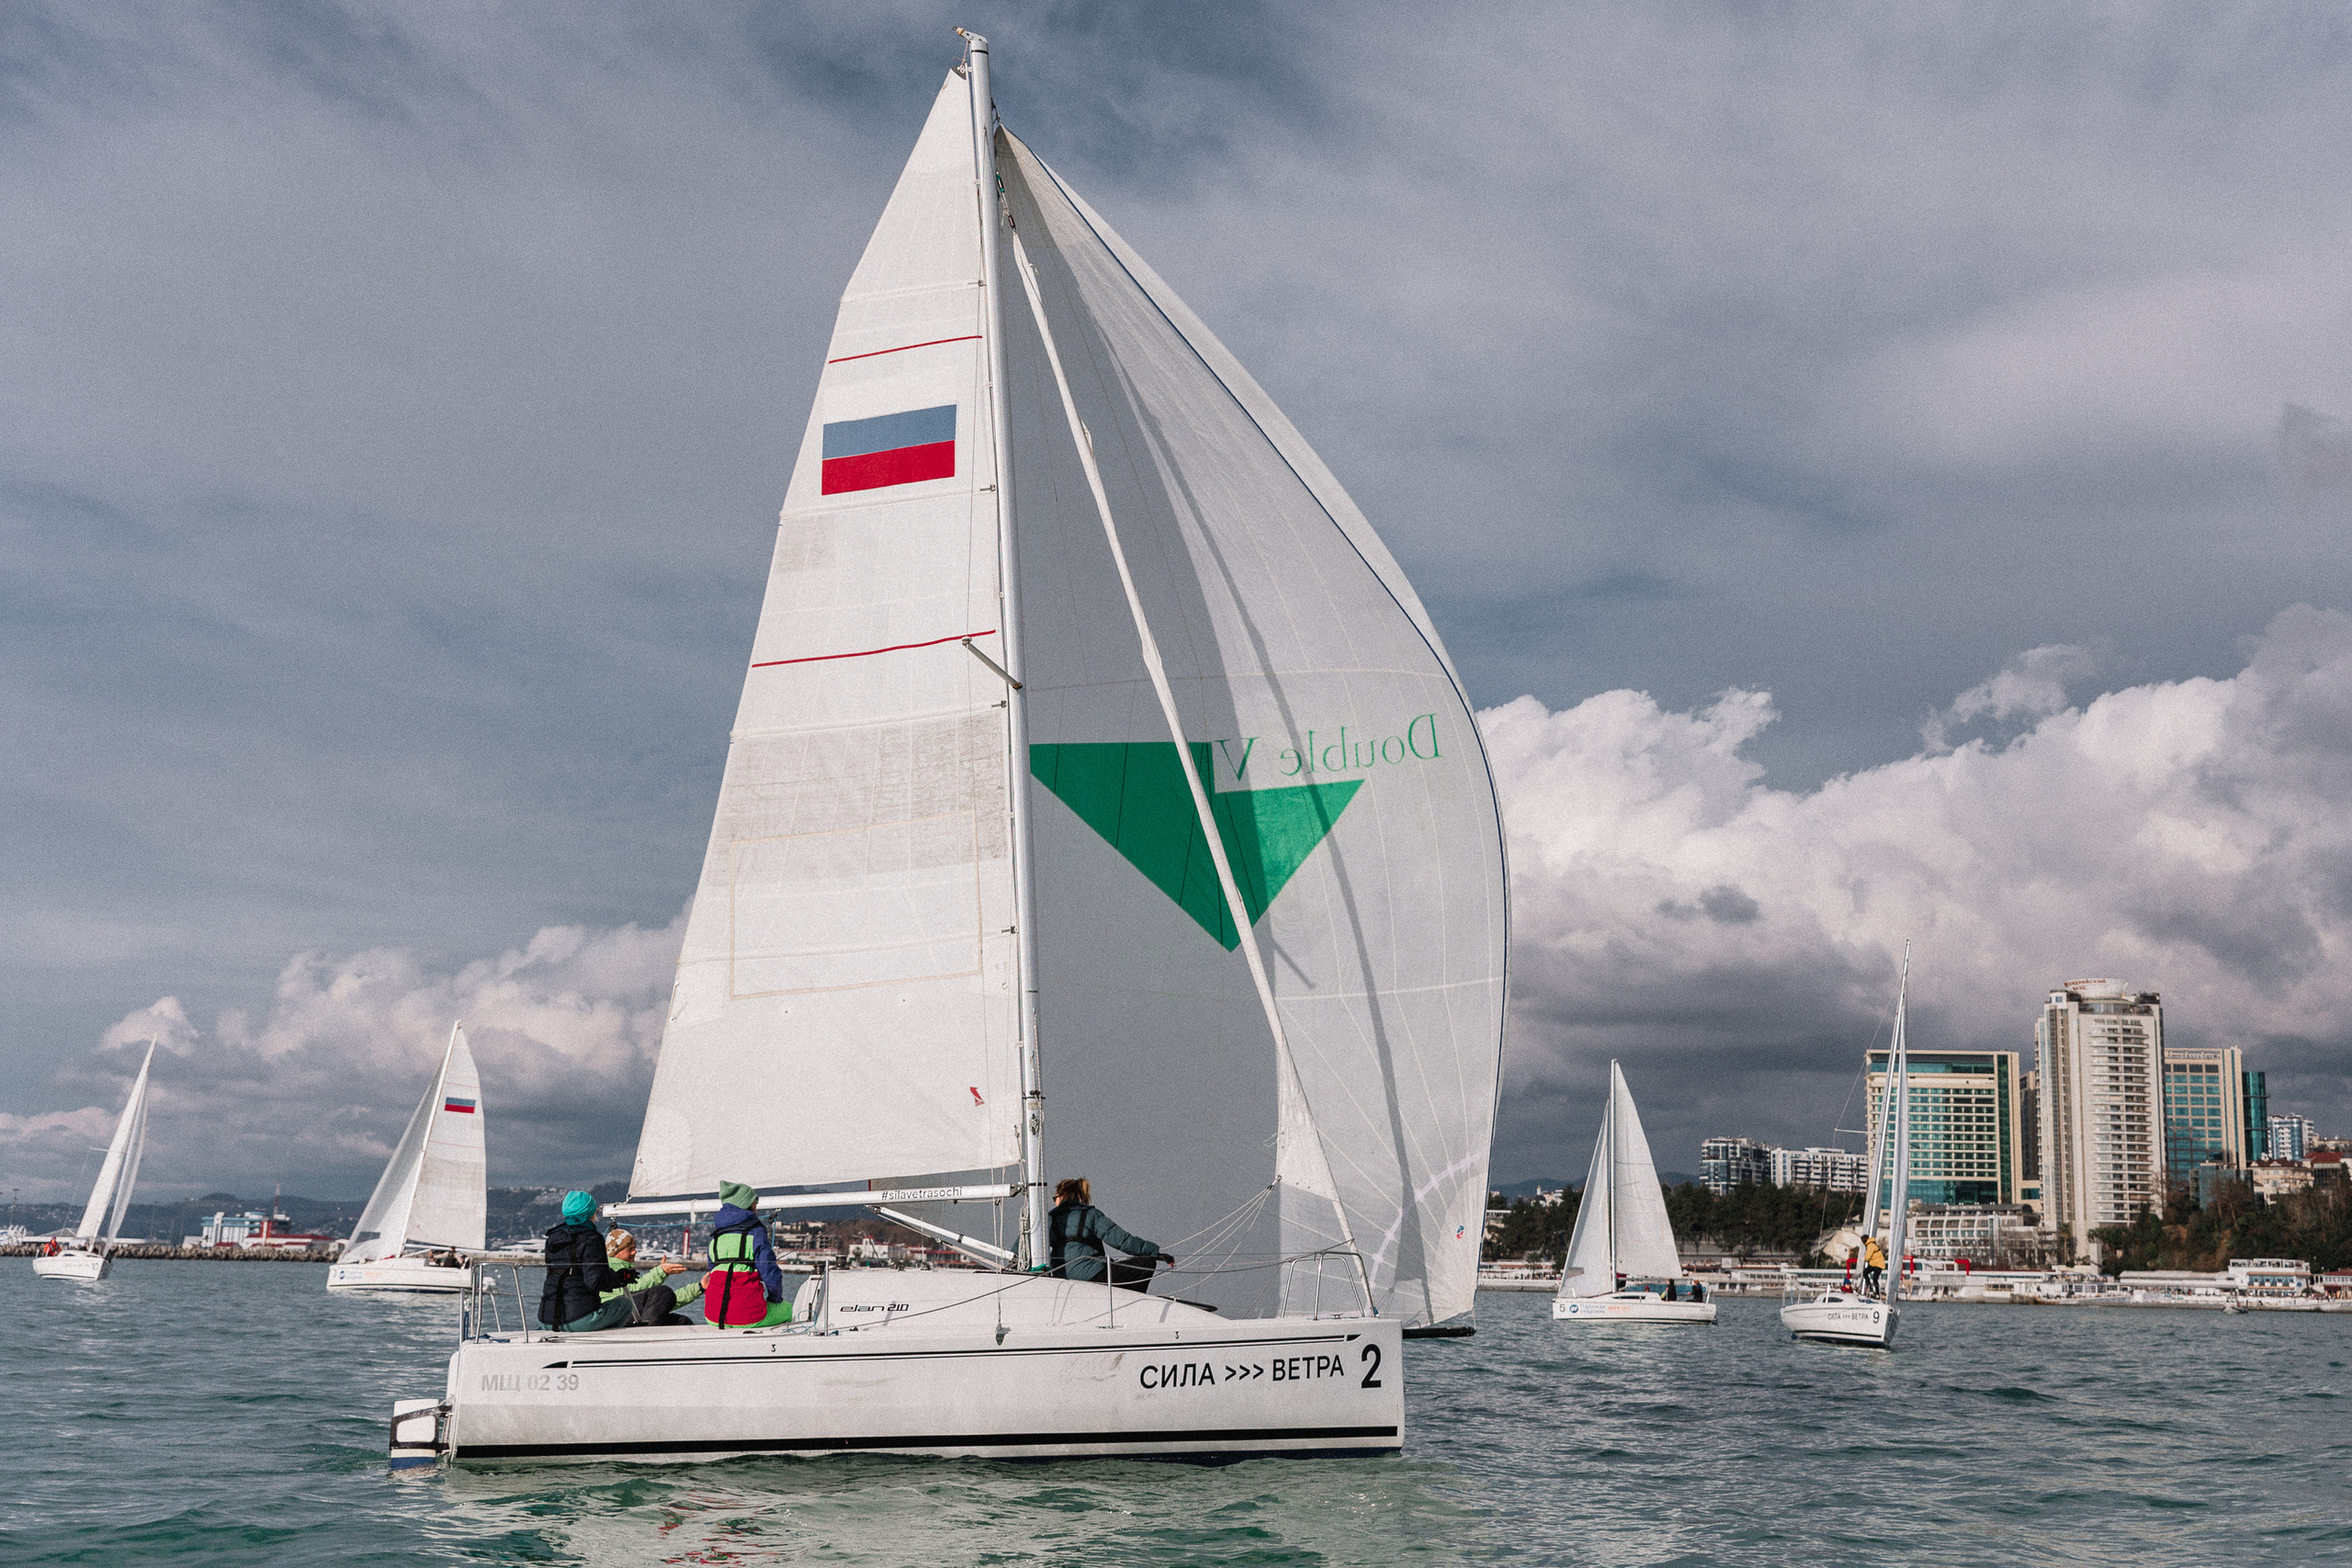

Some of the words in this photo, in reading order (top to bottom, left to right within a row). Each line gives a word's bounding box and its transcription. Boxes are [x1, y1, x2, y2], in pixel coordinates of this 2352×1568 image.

[881, 1186, 963, 1201] #silavetrasochi
[840, 1303, 885, 1312] elan
[887, 1303, 910, 1312] 210
[1559, 1303, 1566, 1312] 5
[1872, 1311, 1880, 1324] 9
[1140, 1363, 1216, 1389] СИЛА
[1272, 1354, 1344, 1382] ВЕТРА
[1361, 1343, 1382, 1389] 2
[527, 1374, 550, 1391] 02
[557, 1373, 579, 1391] 39
